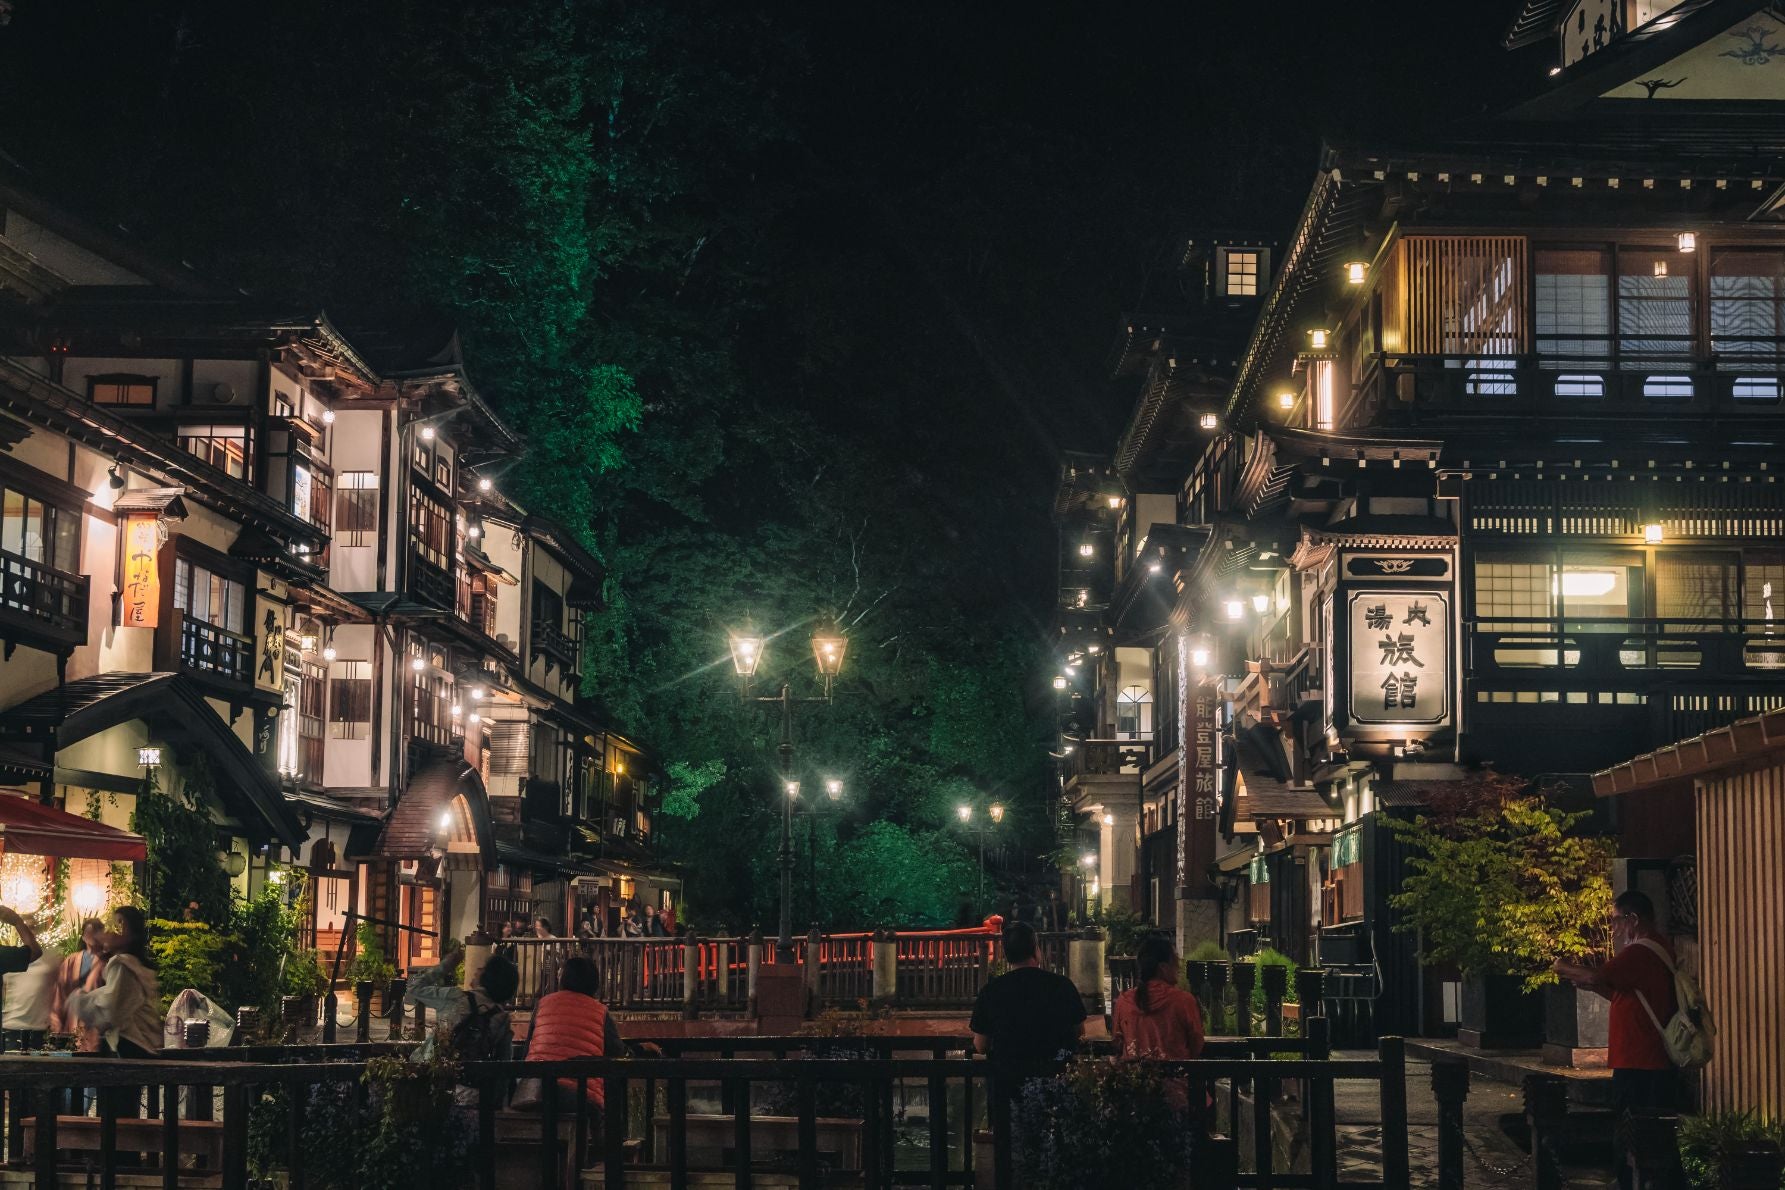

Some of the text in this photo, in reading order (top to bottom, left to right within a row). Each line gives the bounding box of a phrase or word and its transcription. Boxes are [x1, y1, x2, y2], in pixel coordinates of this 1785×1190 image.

[1195, 695, 1214, 820] 能登屋旅館
